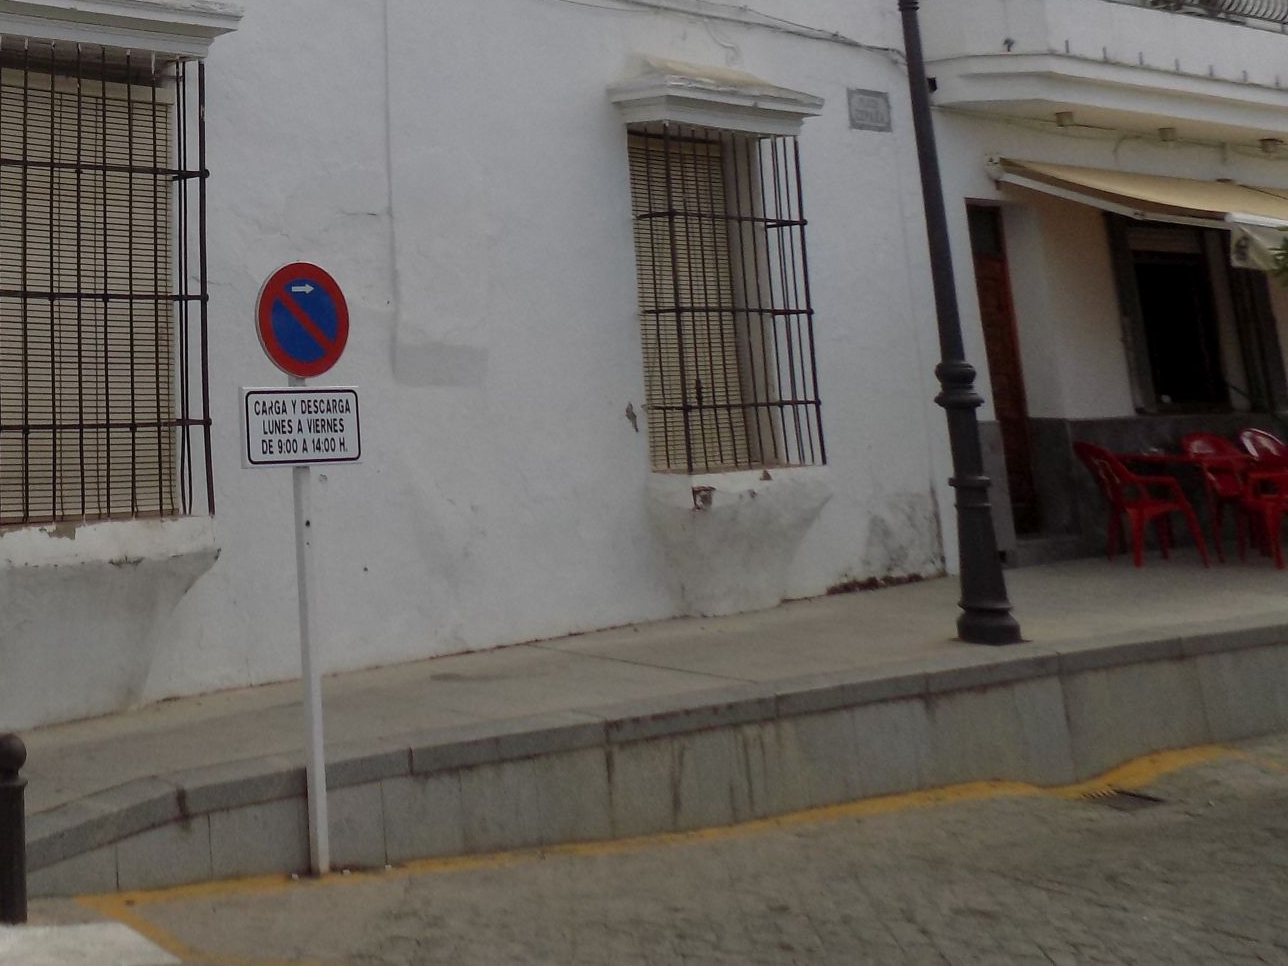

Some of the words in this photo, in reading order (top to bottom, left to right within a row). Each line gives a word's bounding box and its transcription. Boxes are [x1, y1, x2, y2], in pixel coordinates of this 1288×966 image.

[254, 400, 287, 416] CARGA
[291, 400, 297, 414] Y
[300, 399, 351, 414] DESCARGA
[262, 419, 293, 435] LUNES
[297, 419, 304, 434] A
[307, 418, 345, 434] VIERNES
[261, 439, 274, 454] DE
[277, 438, 298, 454] 9:00
[302, 438, 308, 453] A
[312, 437, 336, 453] 14:00
